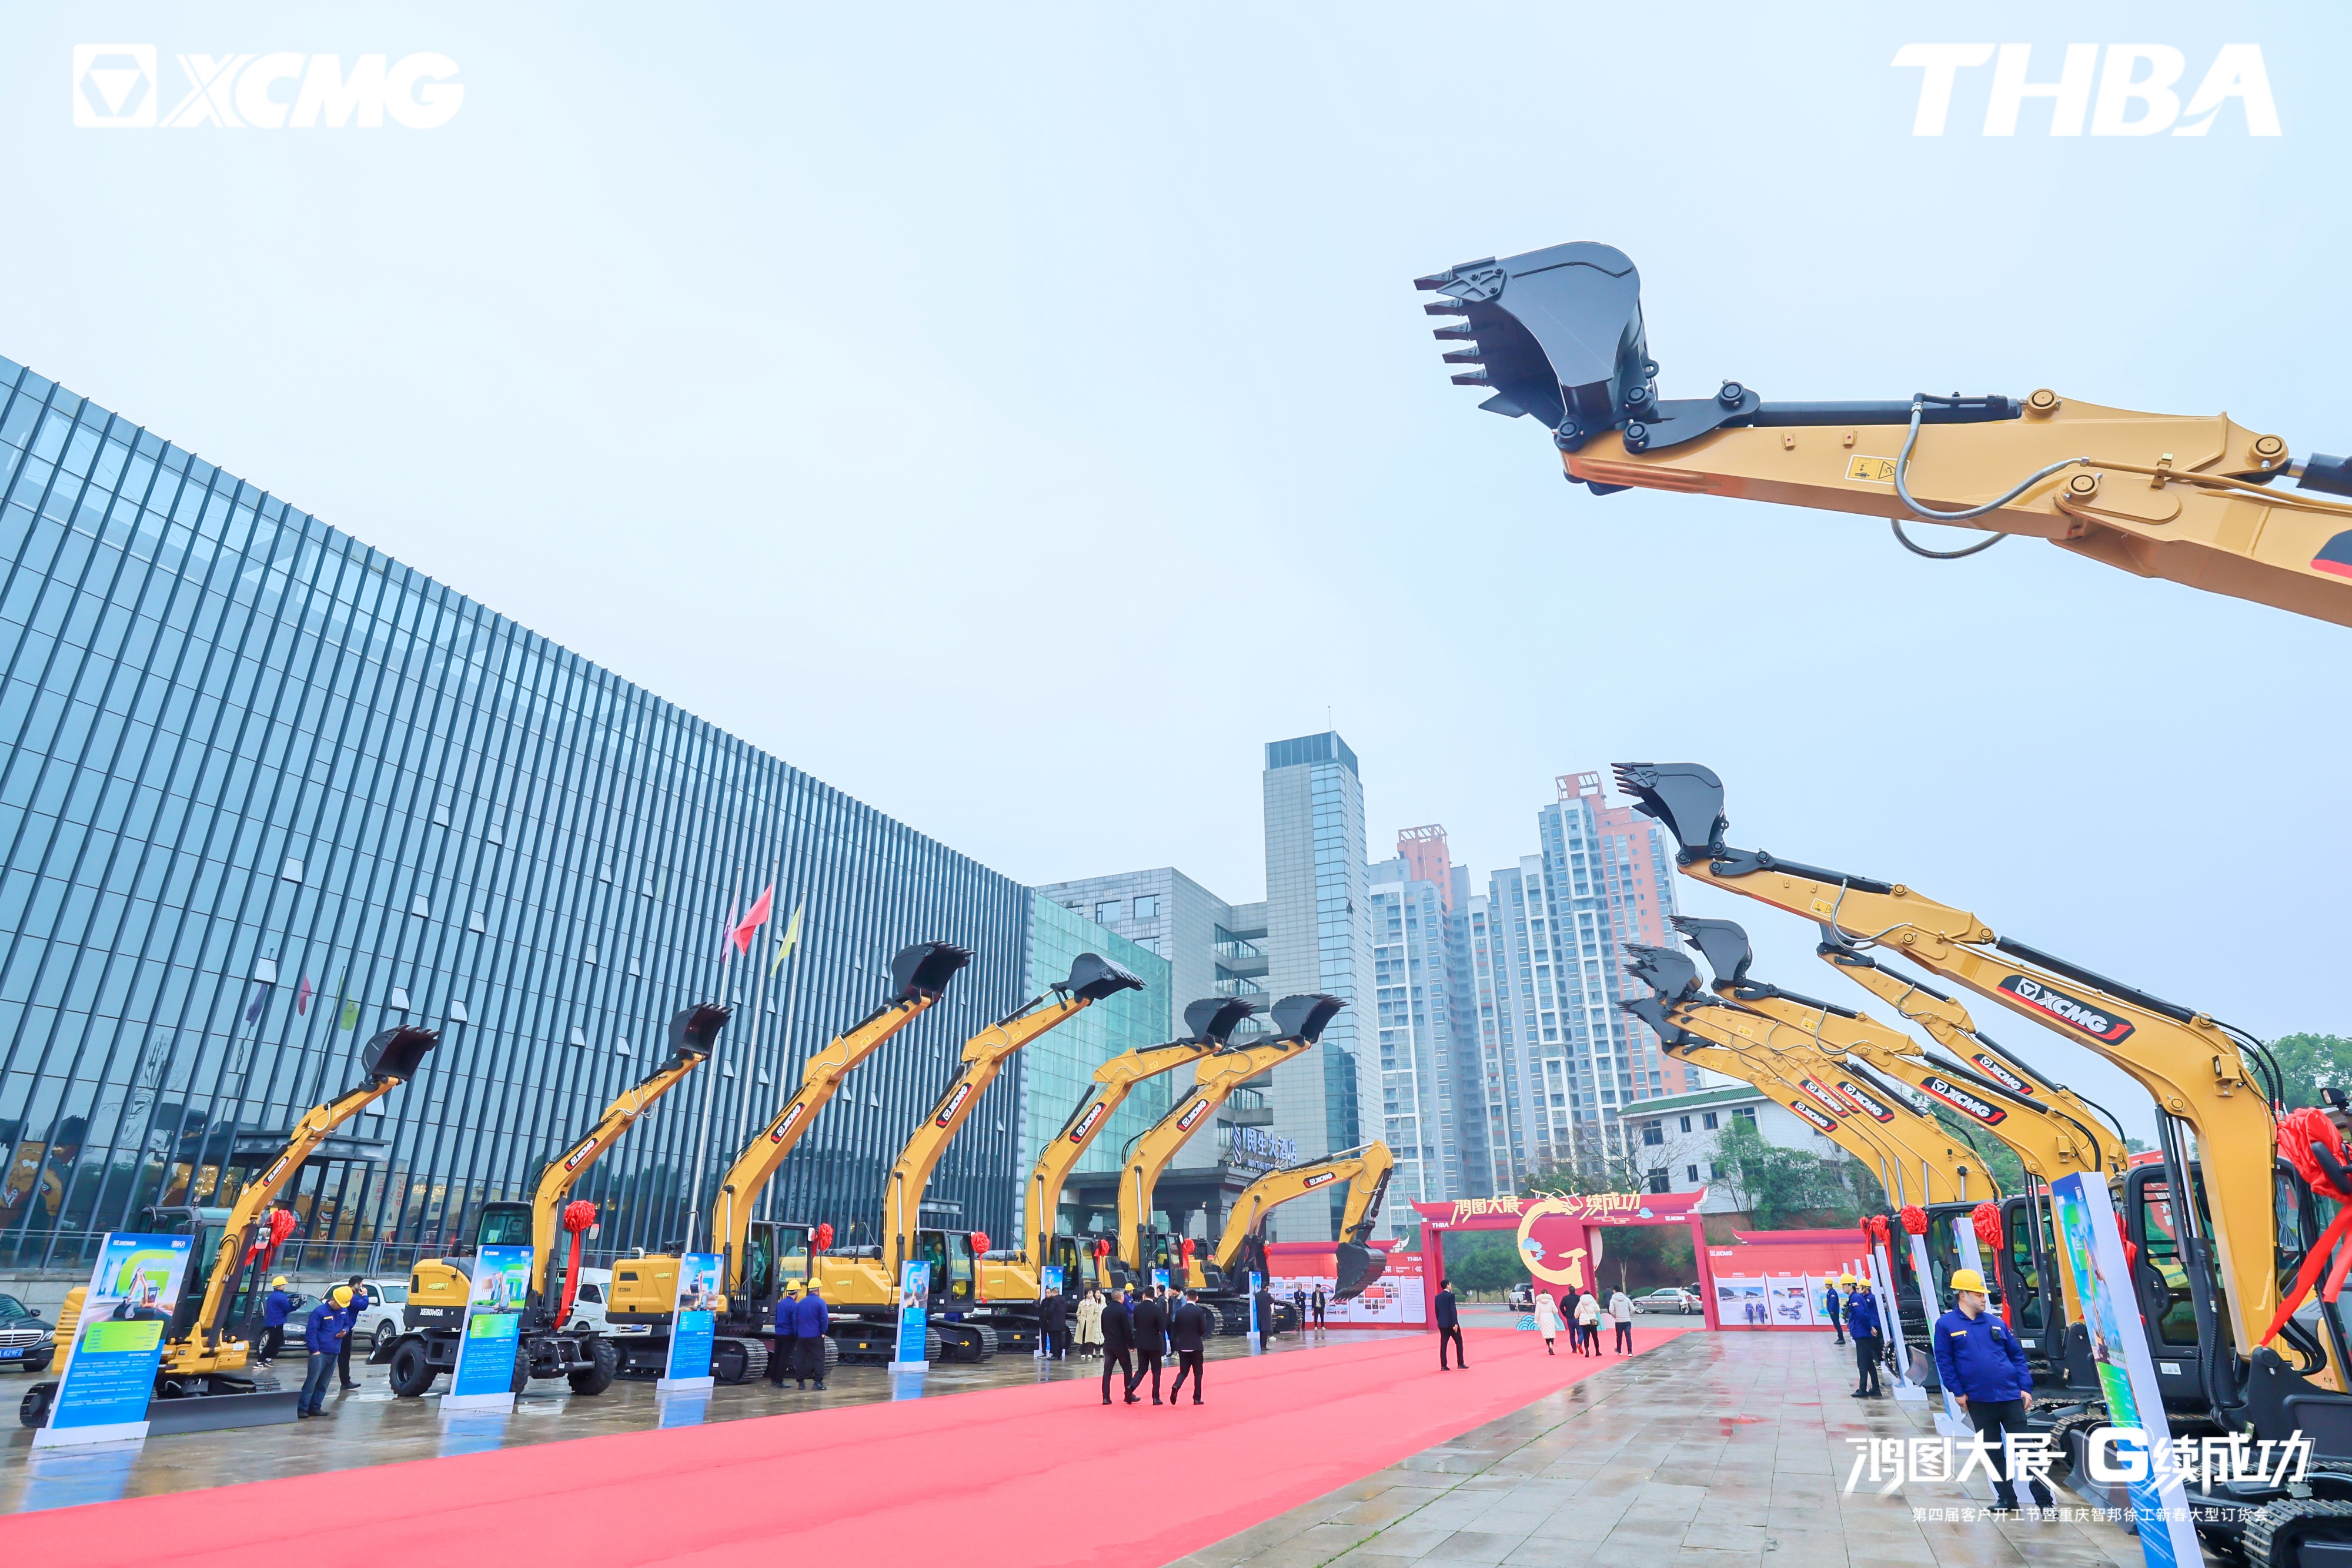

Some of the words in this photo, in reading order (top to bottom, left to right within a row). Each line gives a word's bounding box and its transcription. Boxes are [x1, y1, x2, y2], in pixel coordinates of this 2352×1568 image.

[2033, 990, 2108, 1032] XCMG
[1989, 1064, 2022, 1091] XCMG
[948, 1085, 968, 1114] XCMG
[1188, 1100, 1207, 1122] XCMG
[1813, 1088, 1843, 1112] XCMG
[1852, 1091, 1883, 1116] XCMG
[1945, 1088, 1990, 1117] XCMG
[783, 1105, 801, 1130] XCMG
[1083, 1104, 1102, 1130] XCMG
[1803, 1107, 1829, 1127] XCMG
[576, 1139, 595, 1161] XCMG
[1246, 1127, 1297, 1164] 民生大酒店
[1247, 1158, 1257, 1169] MIN
[1315, 1173, 1333, 1183] XCMG
[1450, 1195, 1524, 1225] 鸿图大展
[1579, 1190, 1641, 1220] 续成功
[419, 1308, 443, 1316] XE60WGA
